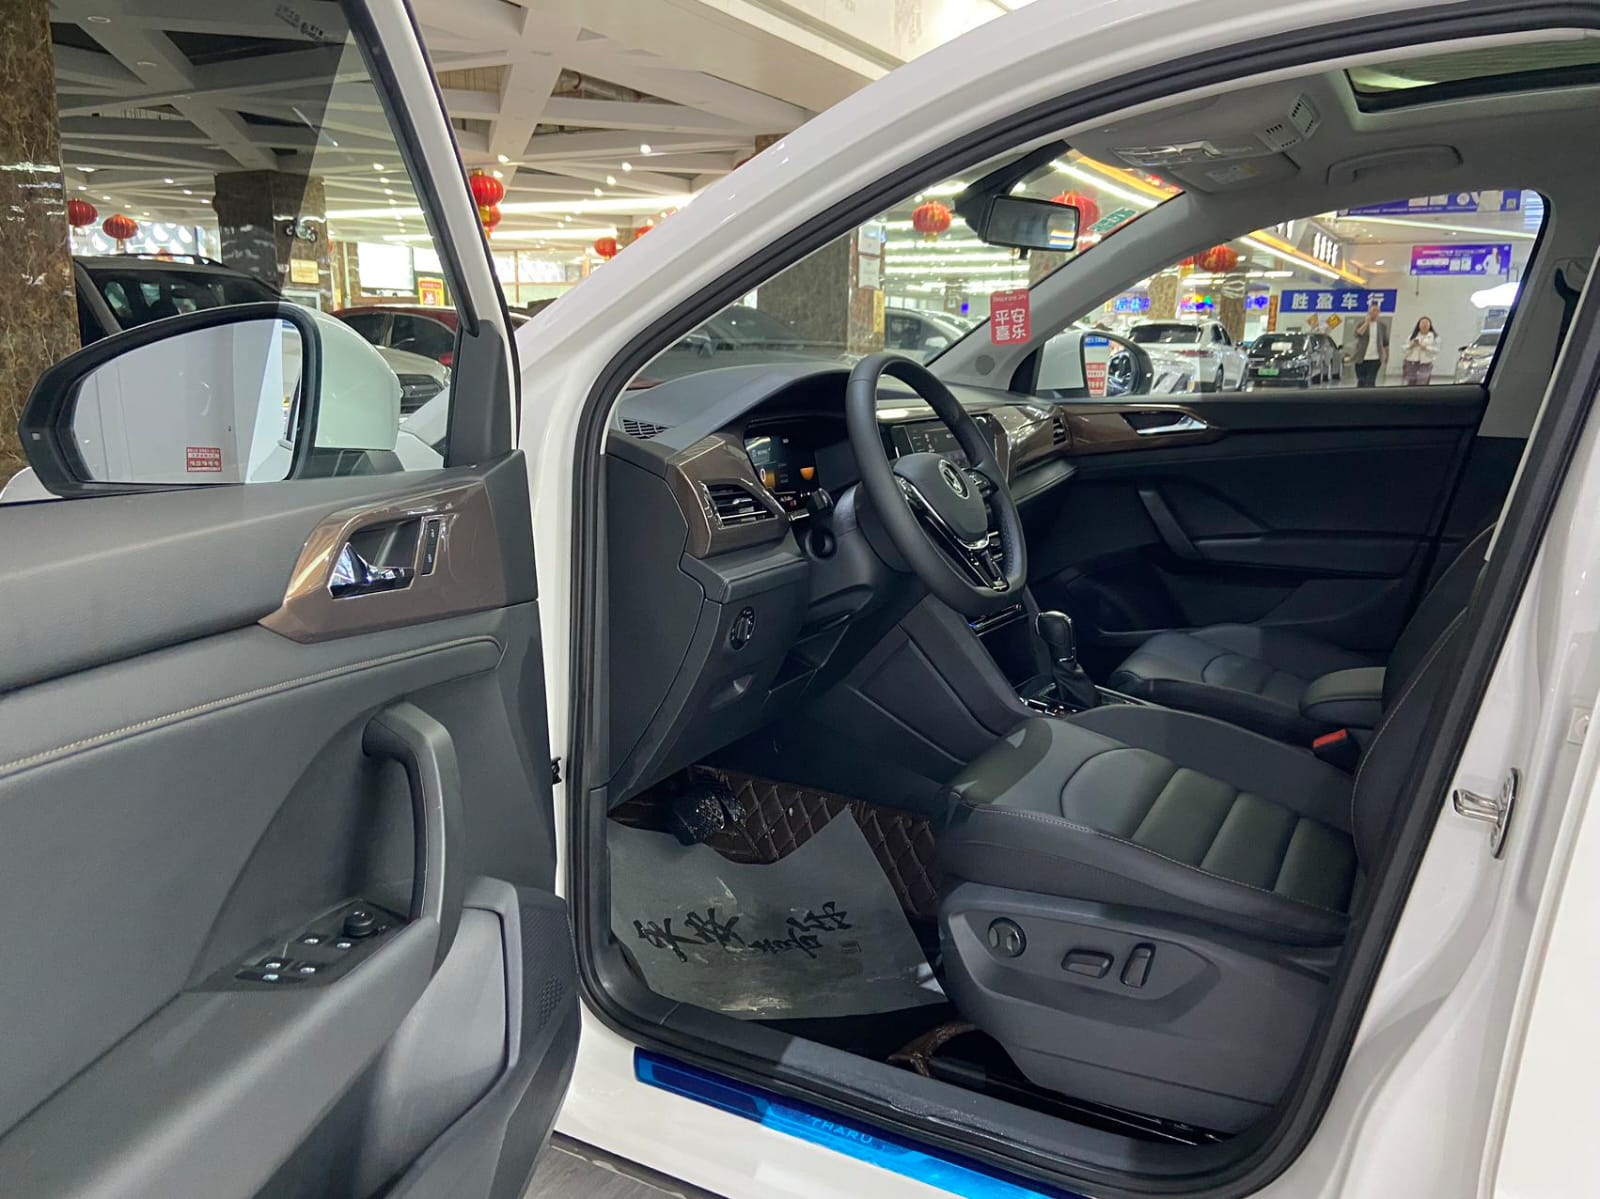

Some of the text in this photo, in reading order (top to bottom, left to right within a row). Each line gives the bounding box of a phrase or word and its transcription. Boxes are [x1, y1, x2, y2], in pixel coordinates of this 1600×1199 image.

[1291, 292, 1385, 310] 胜盈车行
[995, 308, 1025, 325] 平安
[995, 324, 1026, 341] 喜乐
[809, 1117, 874, 1144] THARU
